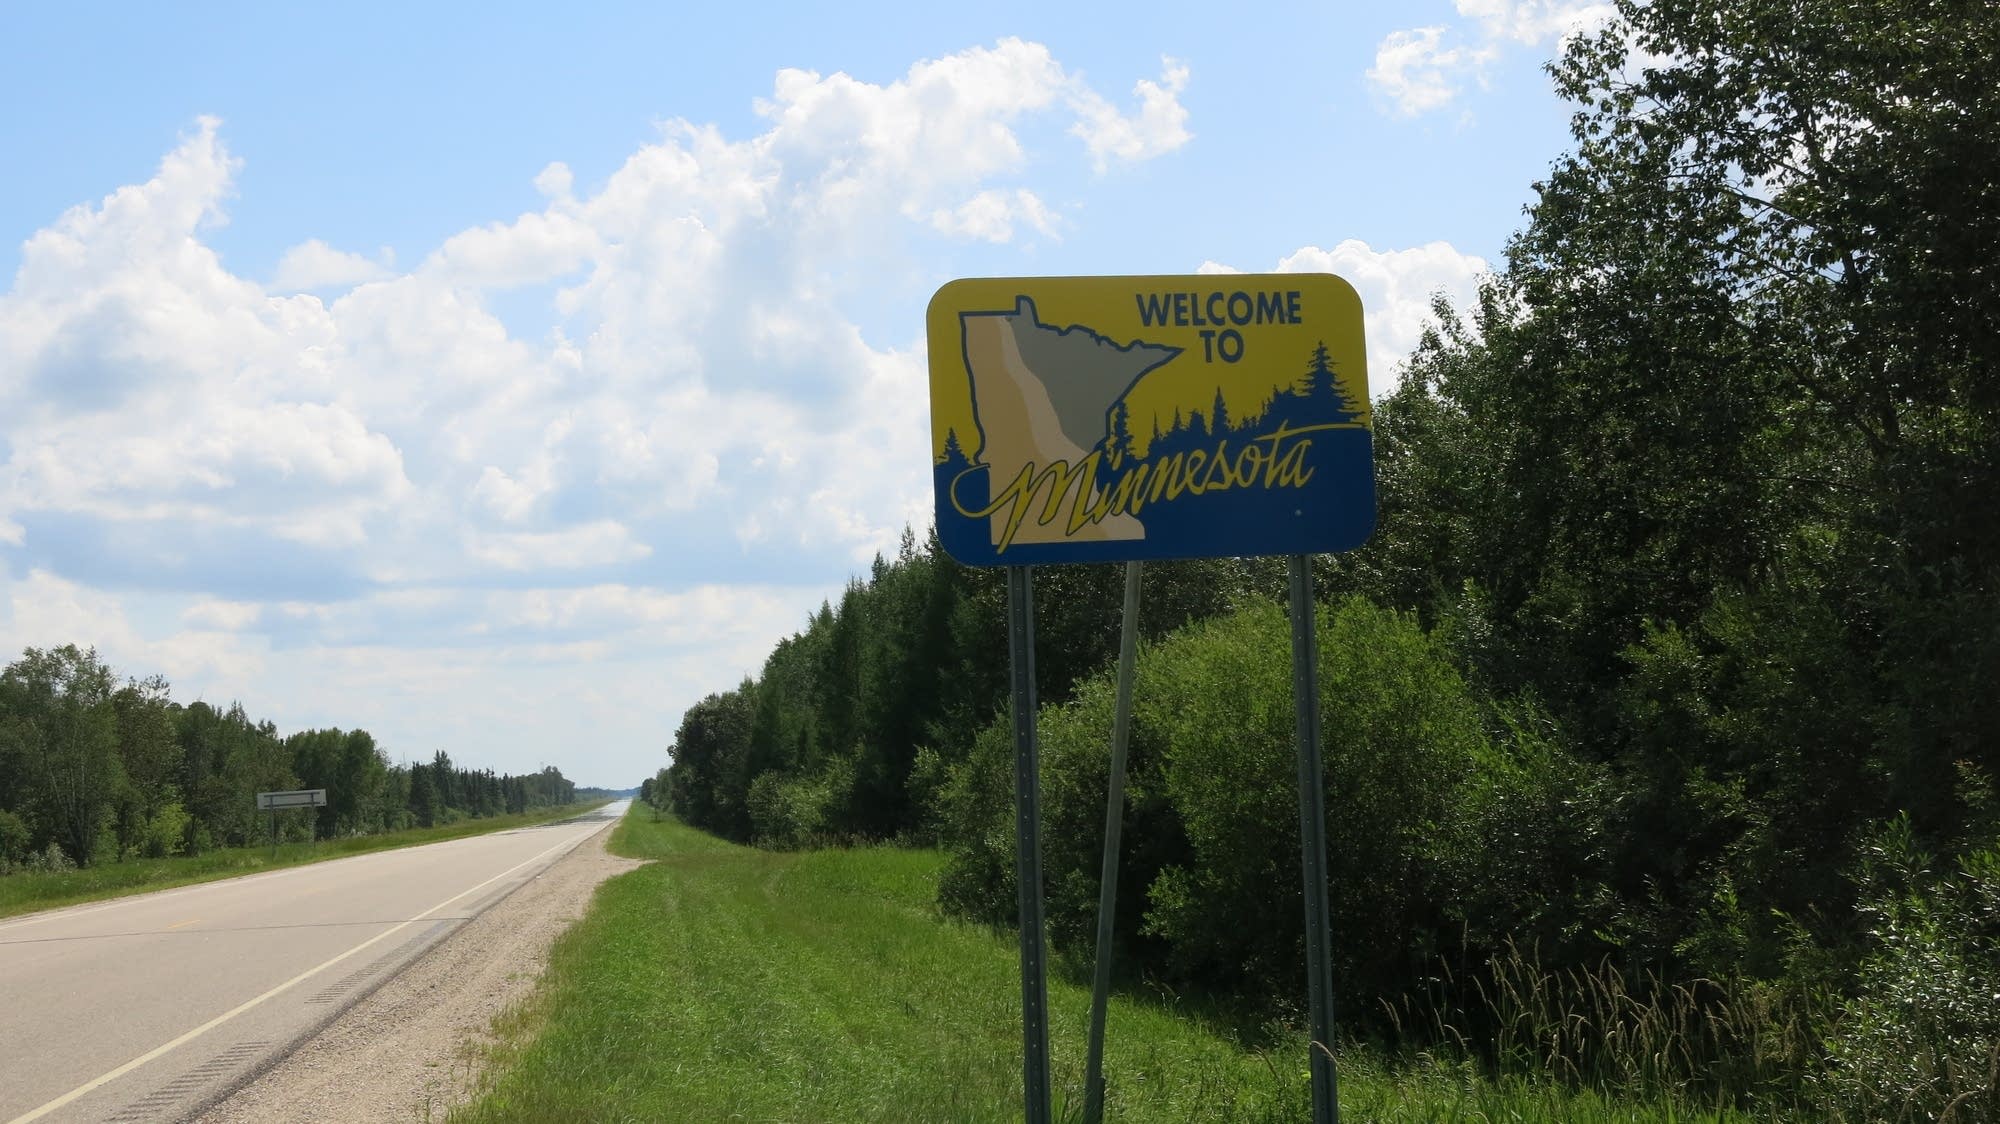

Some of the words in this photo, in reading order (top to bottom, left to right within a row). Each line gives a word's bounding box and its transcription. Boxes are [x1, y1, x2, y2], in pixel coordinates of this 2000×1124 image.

[1136, 291, 1302, 327] WELCOME
[1200, 330, 1244, 363] TO
[950, 420, 1365, 554] Minnesota
